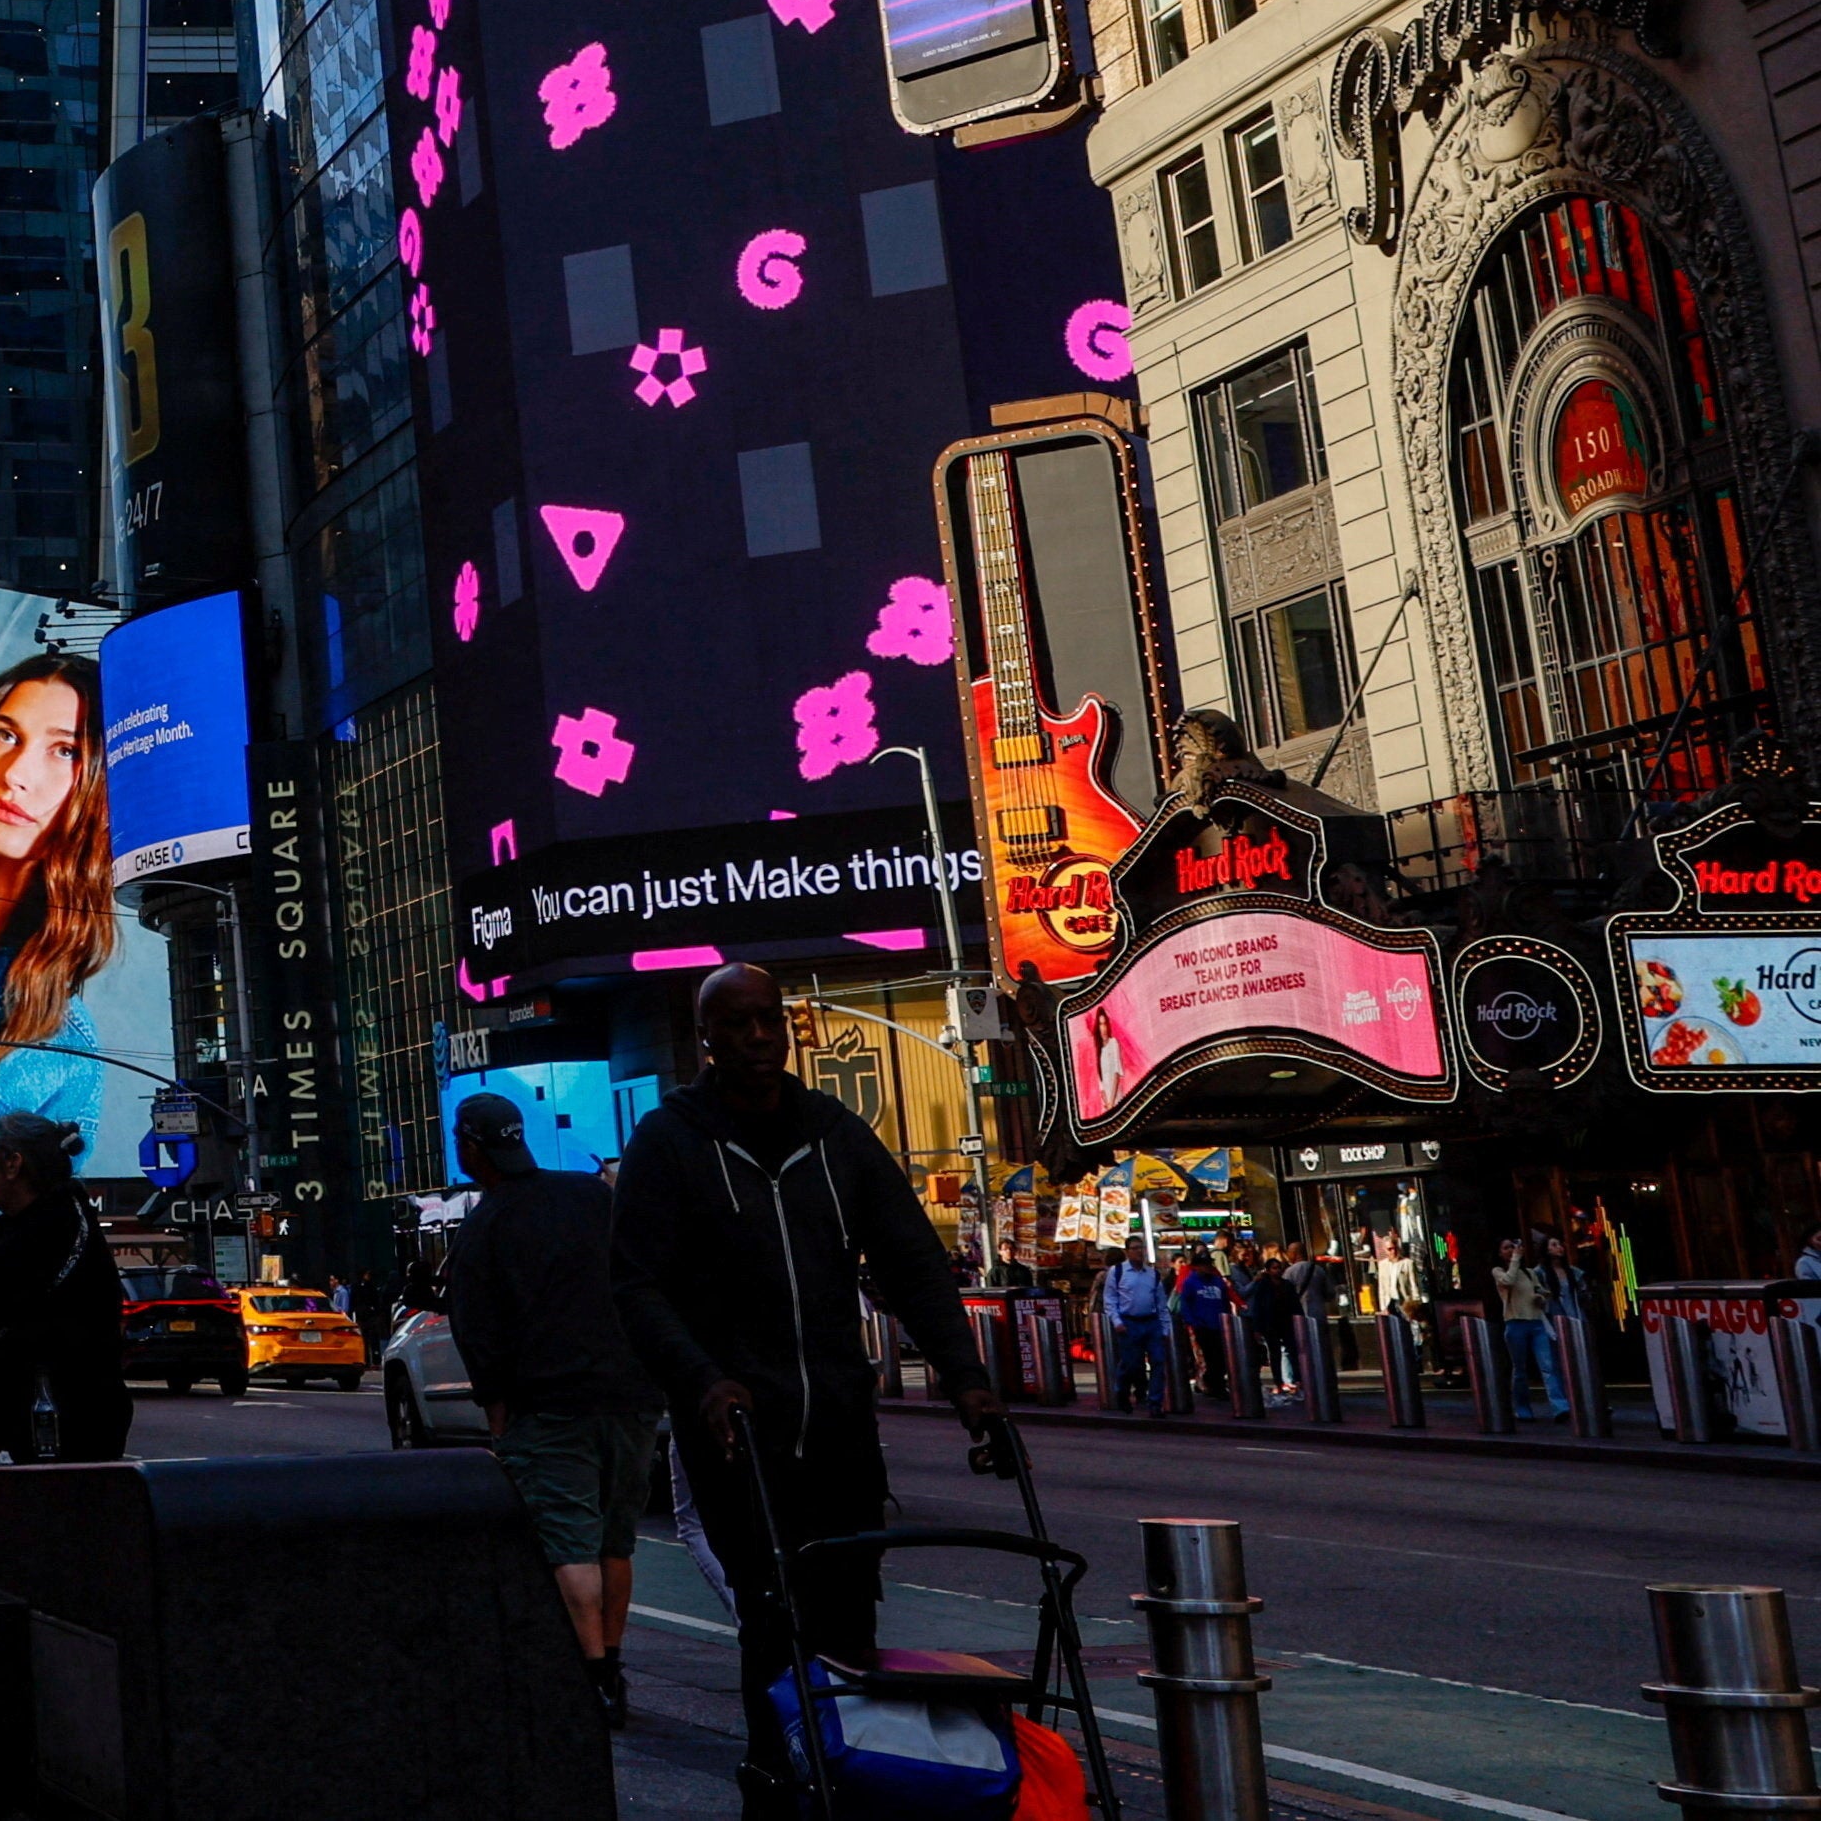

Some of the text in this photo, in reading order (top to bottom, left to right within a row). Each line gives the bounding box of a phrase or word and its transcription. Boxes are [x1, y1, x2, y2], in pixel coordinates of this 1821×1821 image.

[1575, 423, 1621, 463] 1501
[126, 481, 163, 536] 24/7
[124, 703, 169, 732] celebrating
[123, 721, 194, 756] Heritage Month.
[136, 847, 170, 872] CHASE
[1175, 826, 1291, 894] Hard Rock
[1694, 861, 1777, 894] Hard
[471, 844, 982, 951] Figma You can just Make things
[1006, 873, 1082, 913] Hard
[1065, 915, 1114, 933] CAFE
[1174, 935, 1278, 970] TWO ICONIC BRANDS
[1195, 959, 1262, 986] TEAM UP FOR
[1756, 965, 1807, 990] Hard
[266, 776, 324, 1202] 3 TIMES SQUARE
[1159, 972, 1306, 1012] BREAST CANCER AWARENESS
[1385, 986, 1422, 1003] Hard Rock
[509, 1002, 534, 1023] branded
[1477, 1002, 1557, 1022] Hard Rock
[1809, 999, 1821, 1010] CA
[448, 1027, 490, 1071] AT&T
[1005, 1083, 1017, 1095] 43
[1340, 1146, 1362, 1163] ROCK
[1363, 1144, 1386, 1161] SHOP
[171, 1200, 255, 1222] CHAS
[1015, 1299, 1034, 1309] BEAT
[1642, 1300, 1768, 1335] CHICAGO
